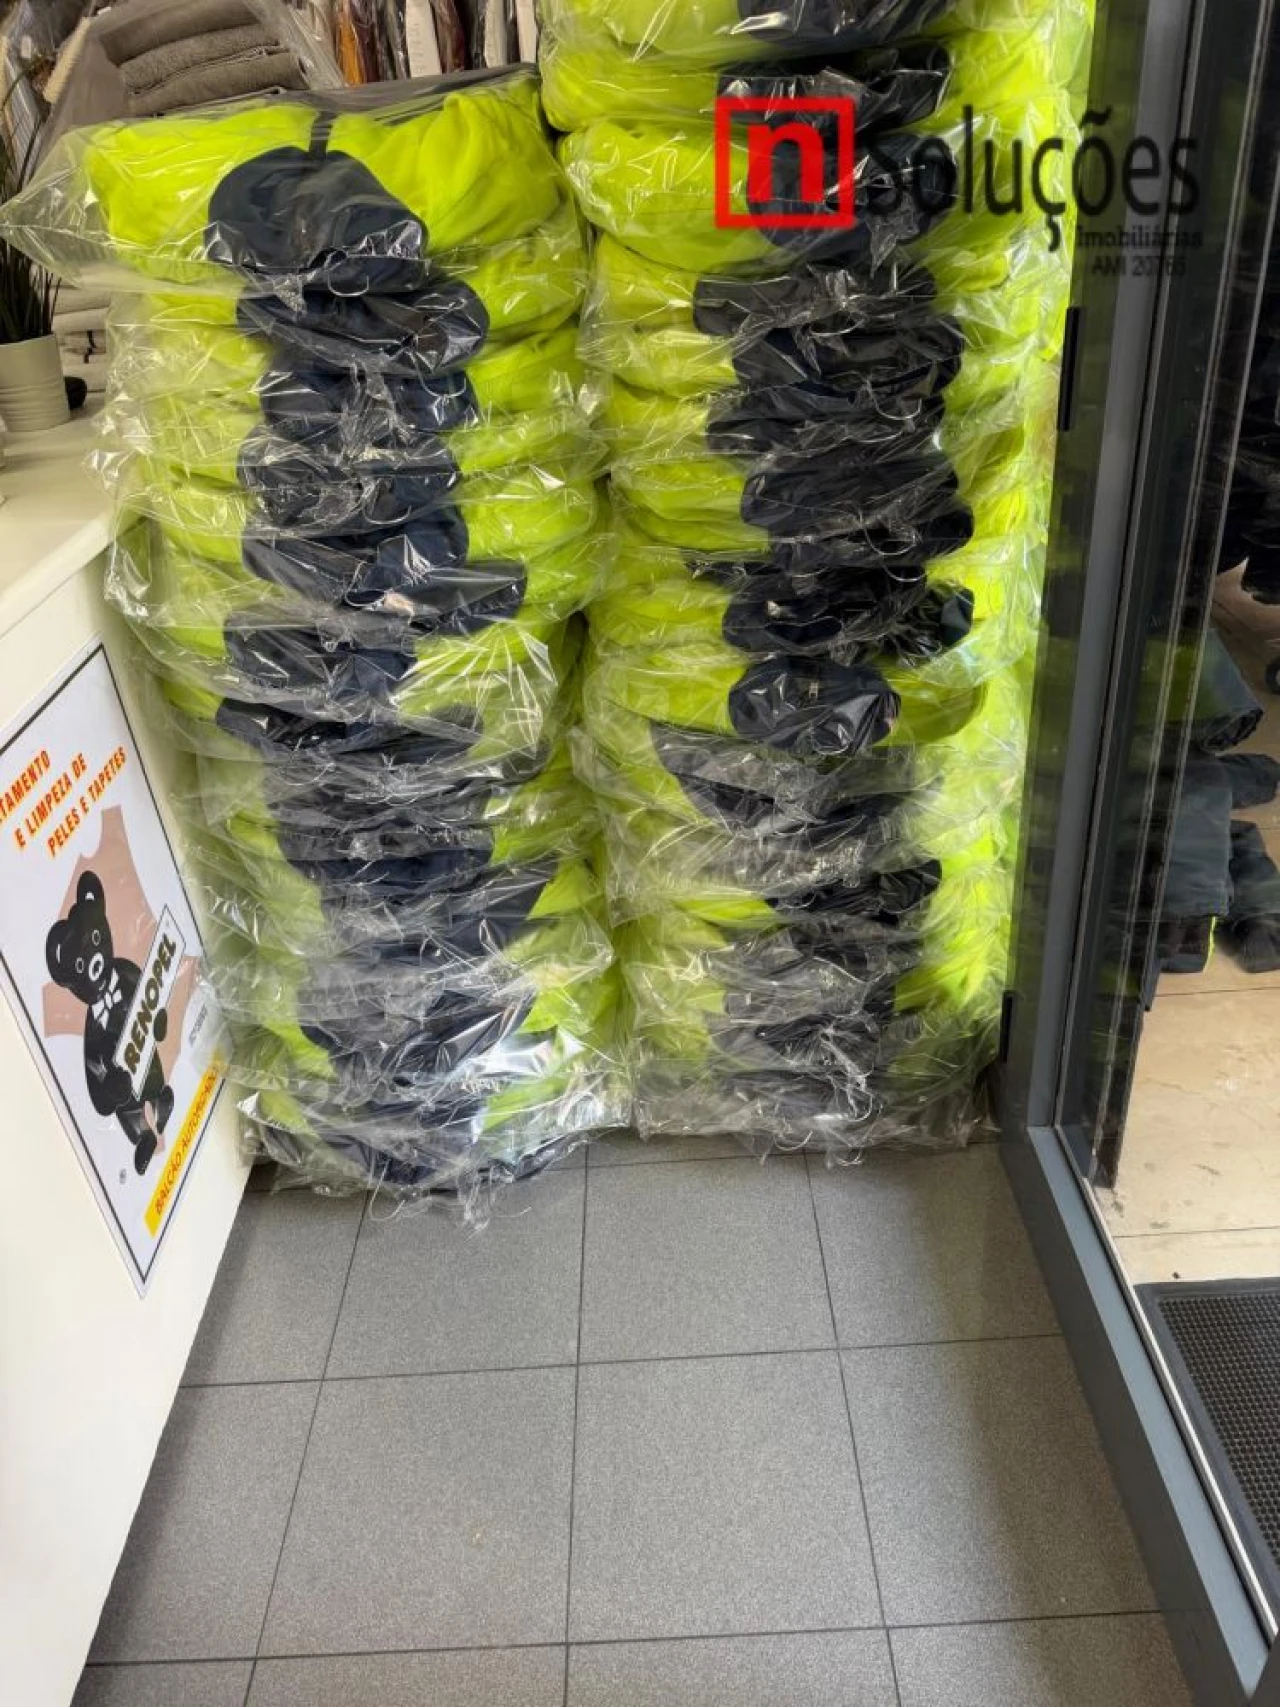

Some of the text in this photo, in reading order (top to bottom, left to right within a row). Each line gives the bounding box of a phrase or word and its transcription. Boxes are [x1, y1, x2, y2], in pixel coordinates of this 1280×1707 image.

[0, 750, 50, 824] TAMENTO
[14, 752, 87, 848] E LIMPEZA DE
[47, 745, 126, 858] PELES E TAPETES
[124, 932, 176, 1075] RENOPEL
